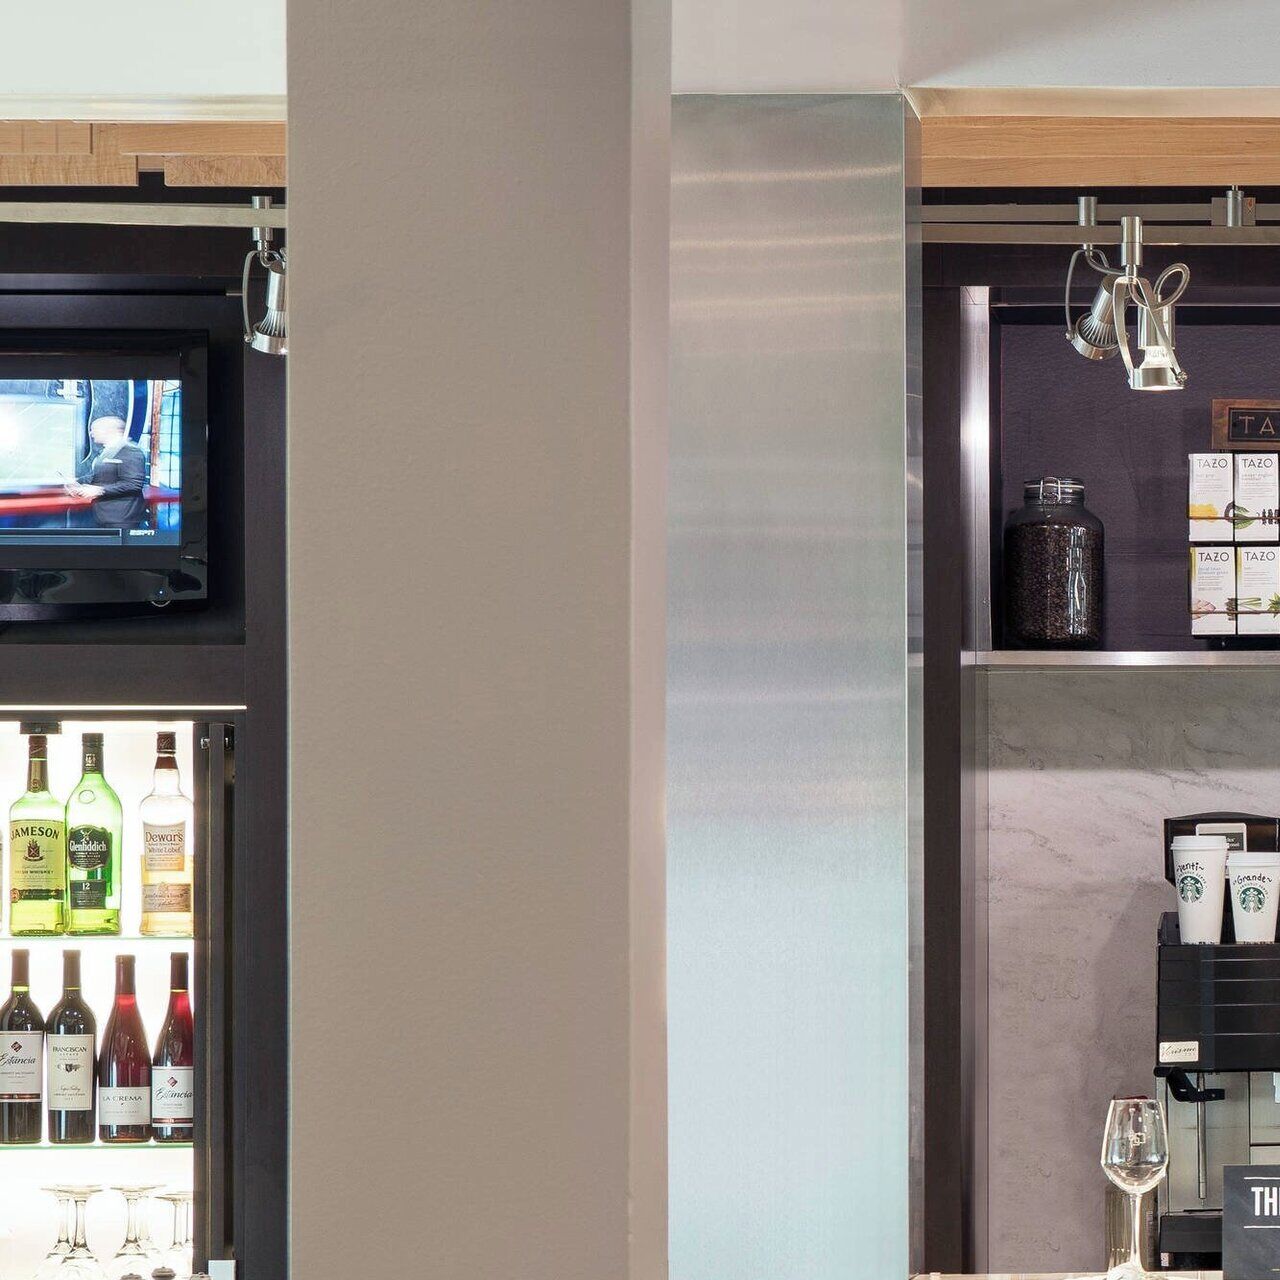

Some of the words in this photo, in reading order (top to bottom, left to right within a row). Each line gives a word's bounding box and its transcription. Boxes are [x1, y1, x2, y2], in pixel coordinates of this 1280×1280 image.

[1197, 459, 1227, 468] TAZO
[1198, 552, 1229, 562] TAZO
[11, 826, 60, 841] JAMESON
[145, 832, 183, 842] Dewar's
[70, 840, 107, 851] Glenfiddich
[82, 882, 90, 890] 12
